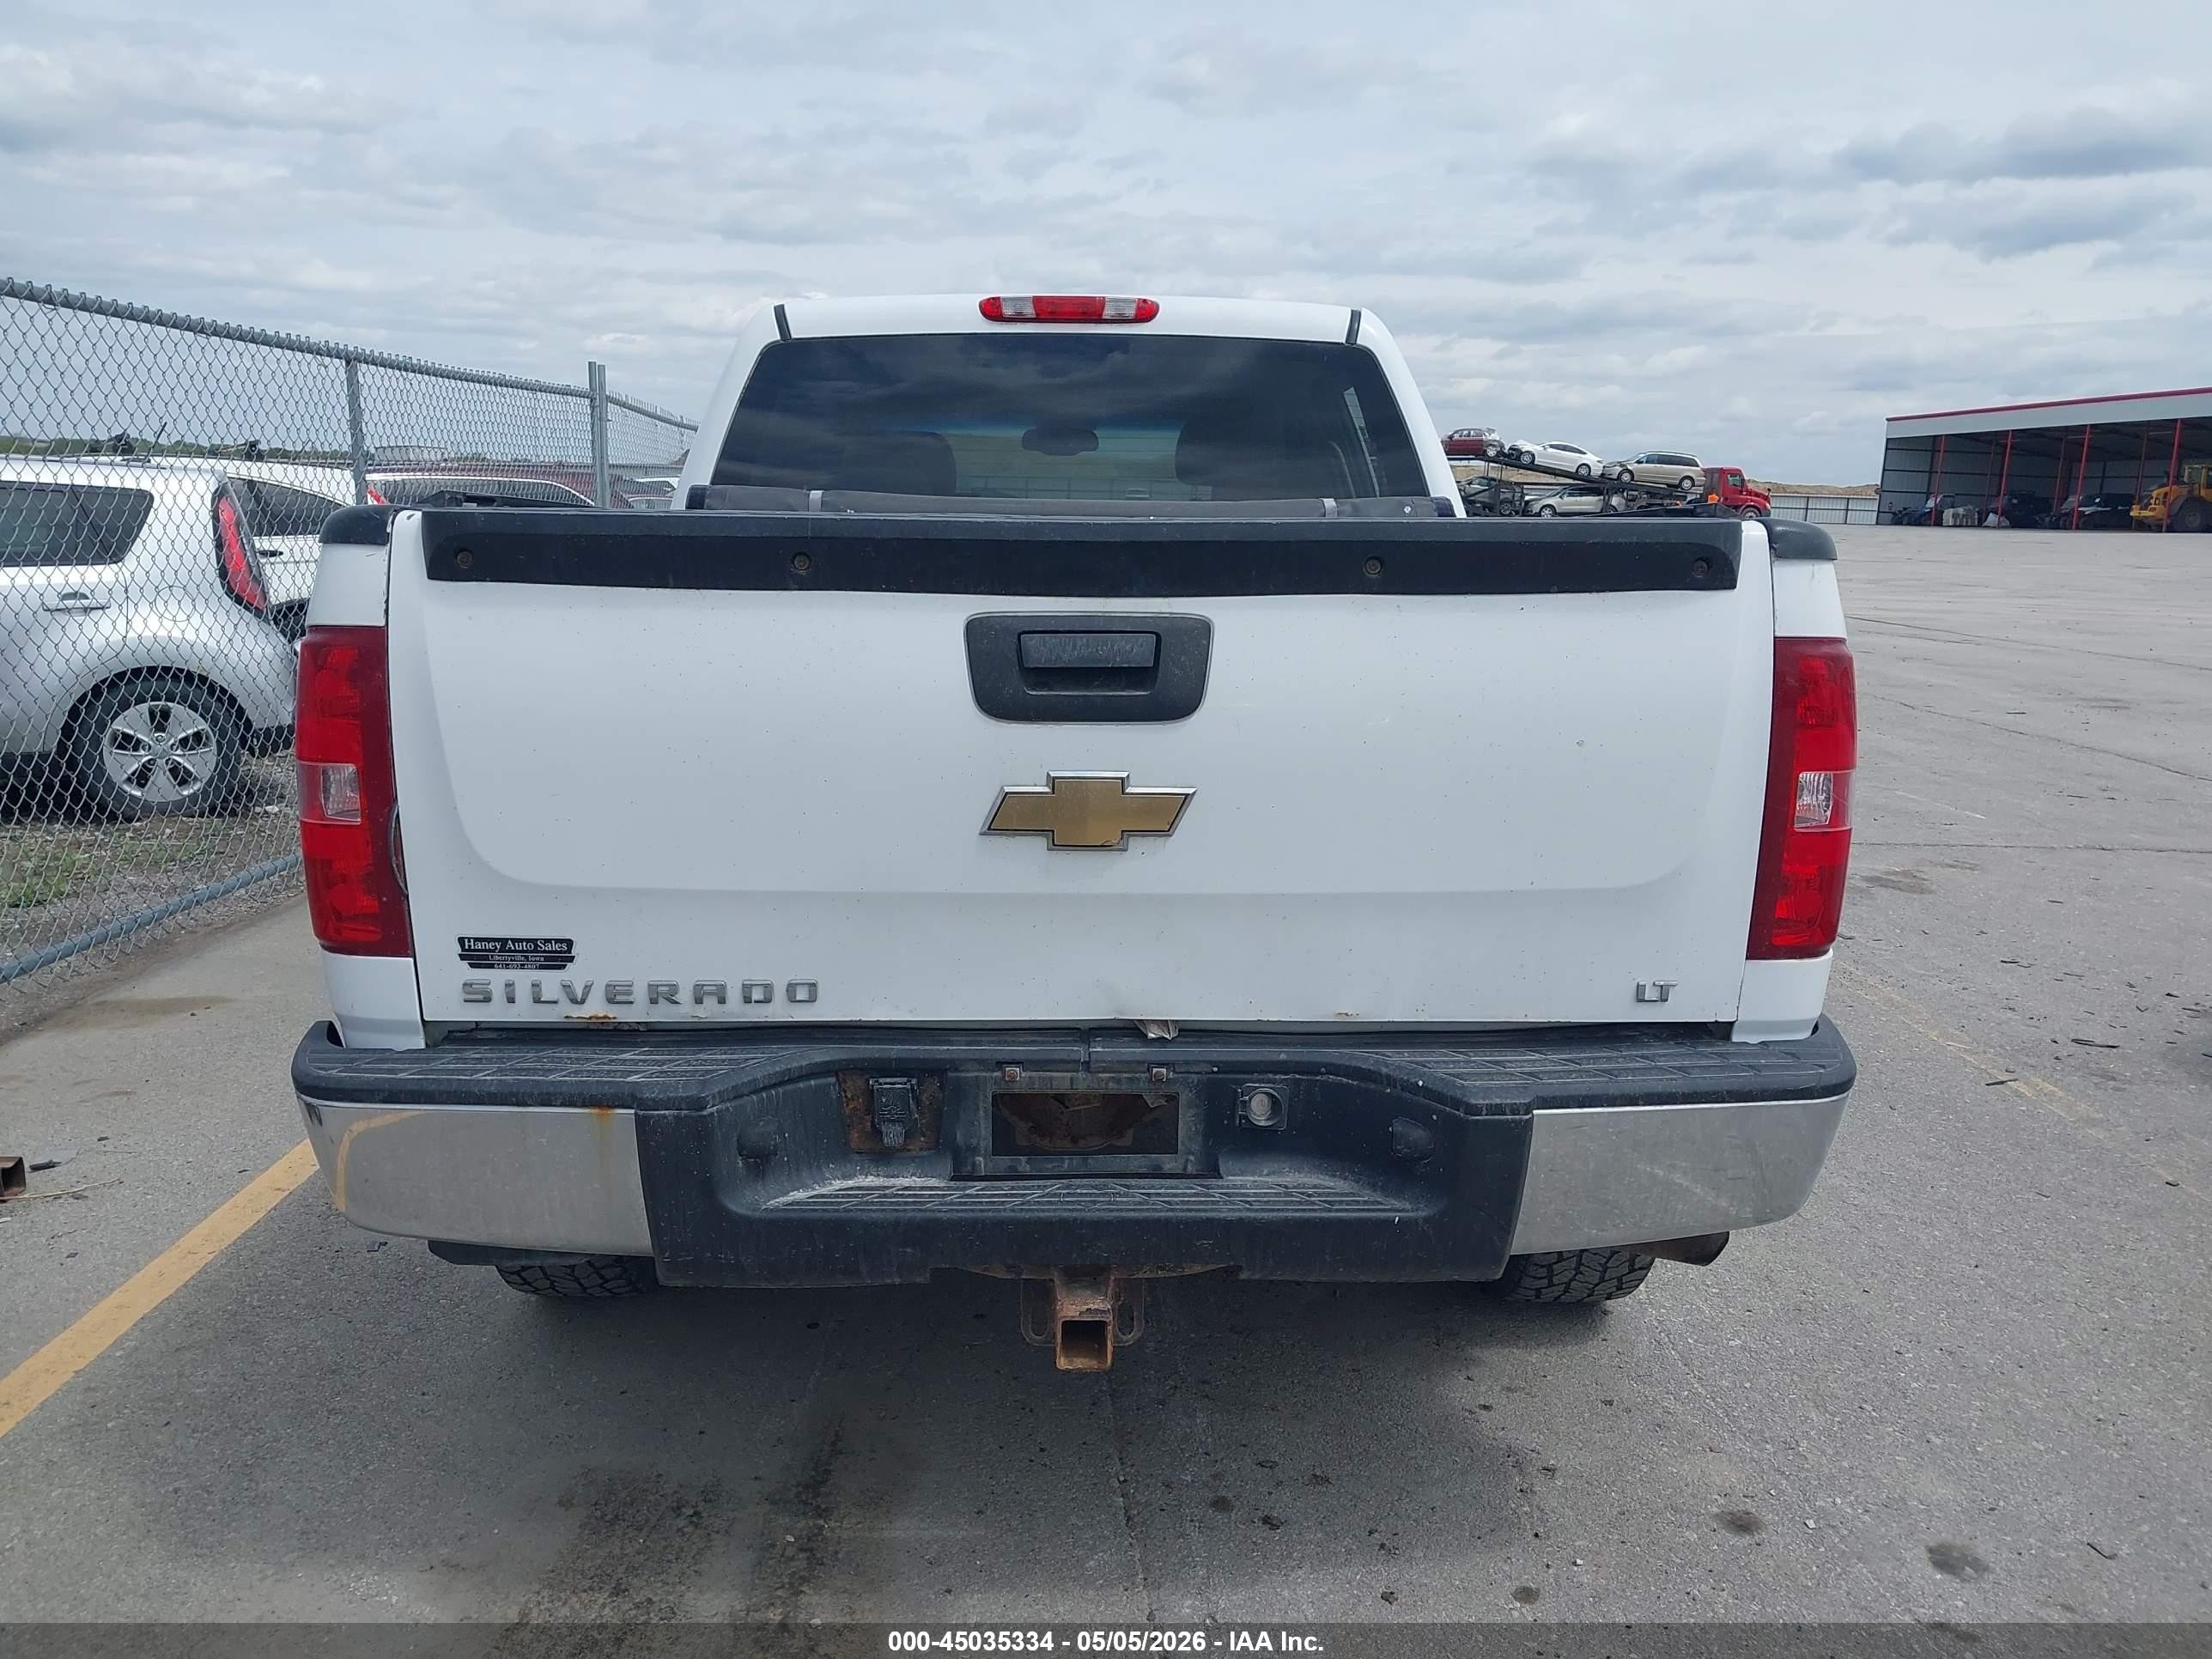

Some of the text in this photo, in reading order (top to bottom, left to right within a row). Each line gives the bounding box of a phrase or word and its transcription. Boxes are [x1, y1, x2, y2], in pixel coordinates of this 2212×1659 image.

[465, 939, 568, 952] Haney Auto Sales
[462, 978, 819, 1005] SILVERADO
[1636, 981, 1678, 1003] LT
